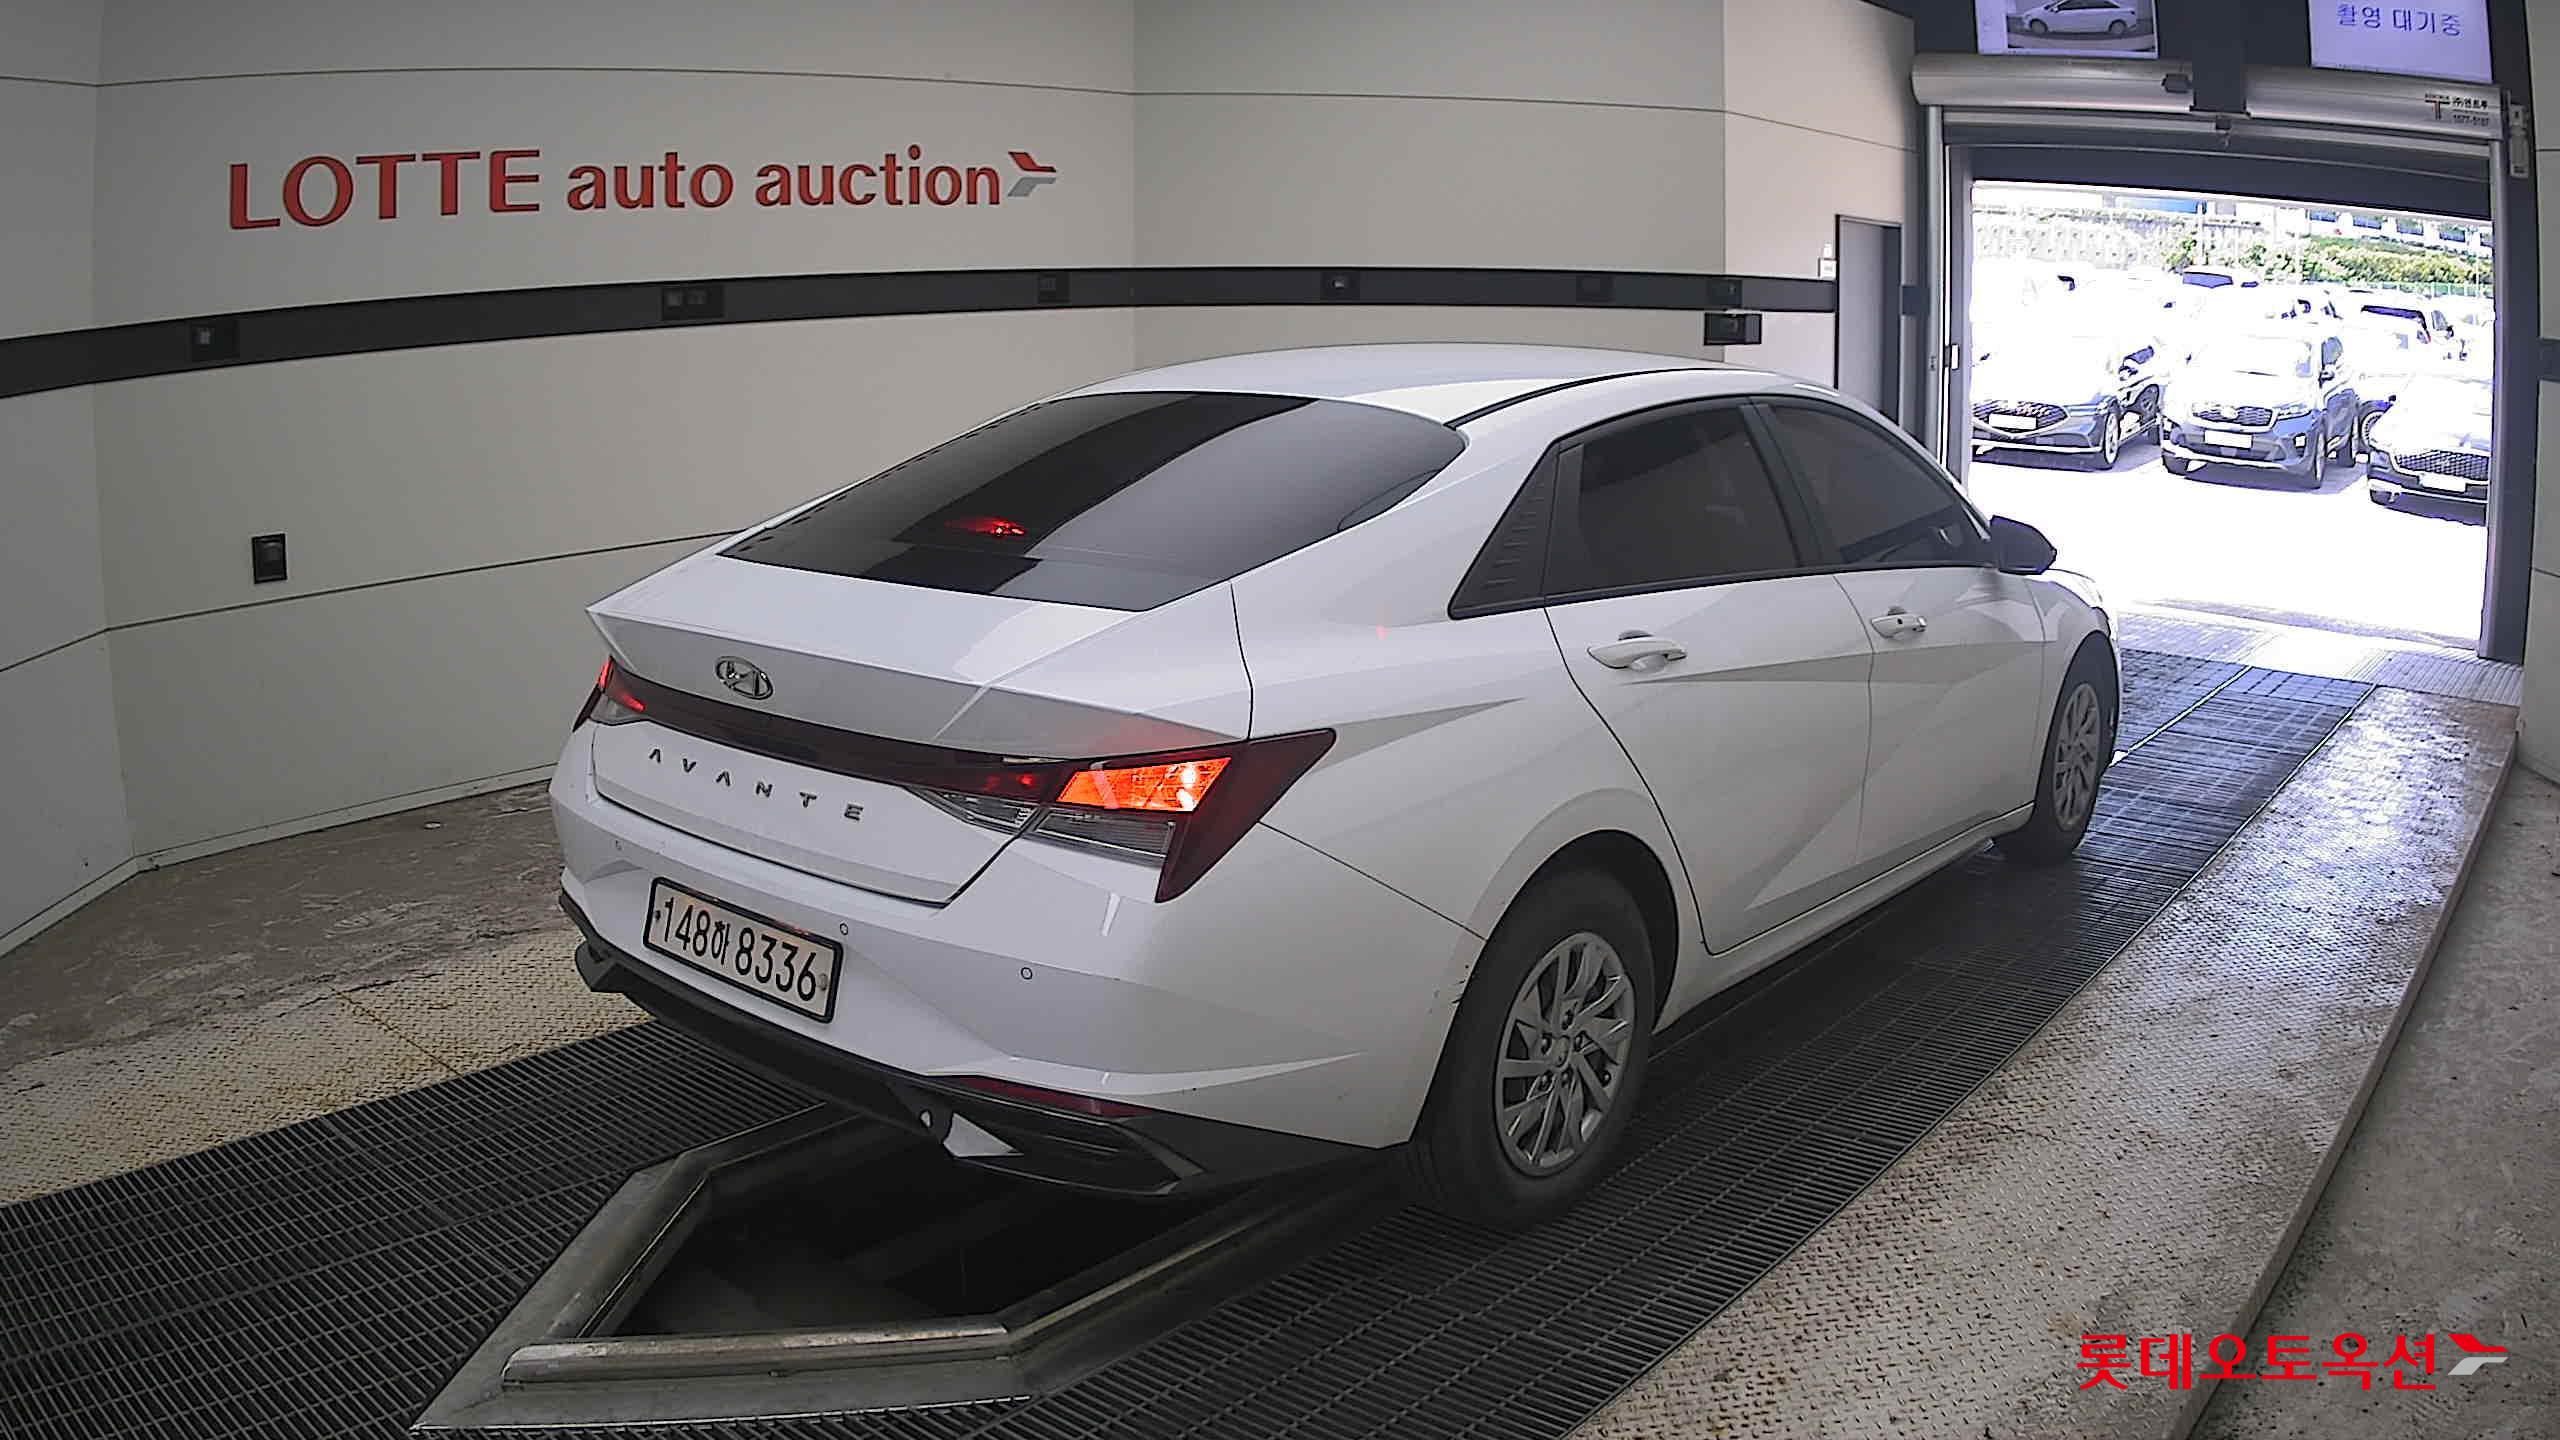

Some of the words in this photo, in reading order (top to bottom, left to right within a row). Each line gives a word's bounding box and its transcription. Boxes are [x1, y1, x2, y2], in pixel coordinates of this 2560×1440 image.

[2337, 4, 2381, 29] 촬영
[2392, 9, 2461, 36] 대기중
[230, 149, 540, 230] LOTTE
[566, 152, 735, 209] auto
[755, 145, 1002, 207] auction
[649, 748, 864, 821] AVANTE
